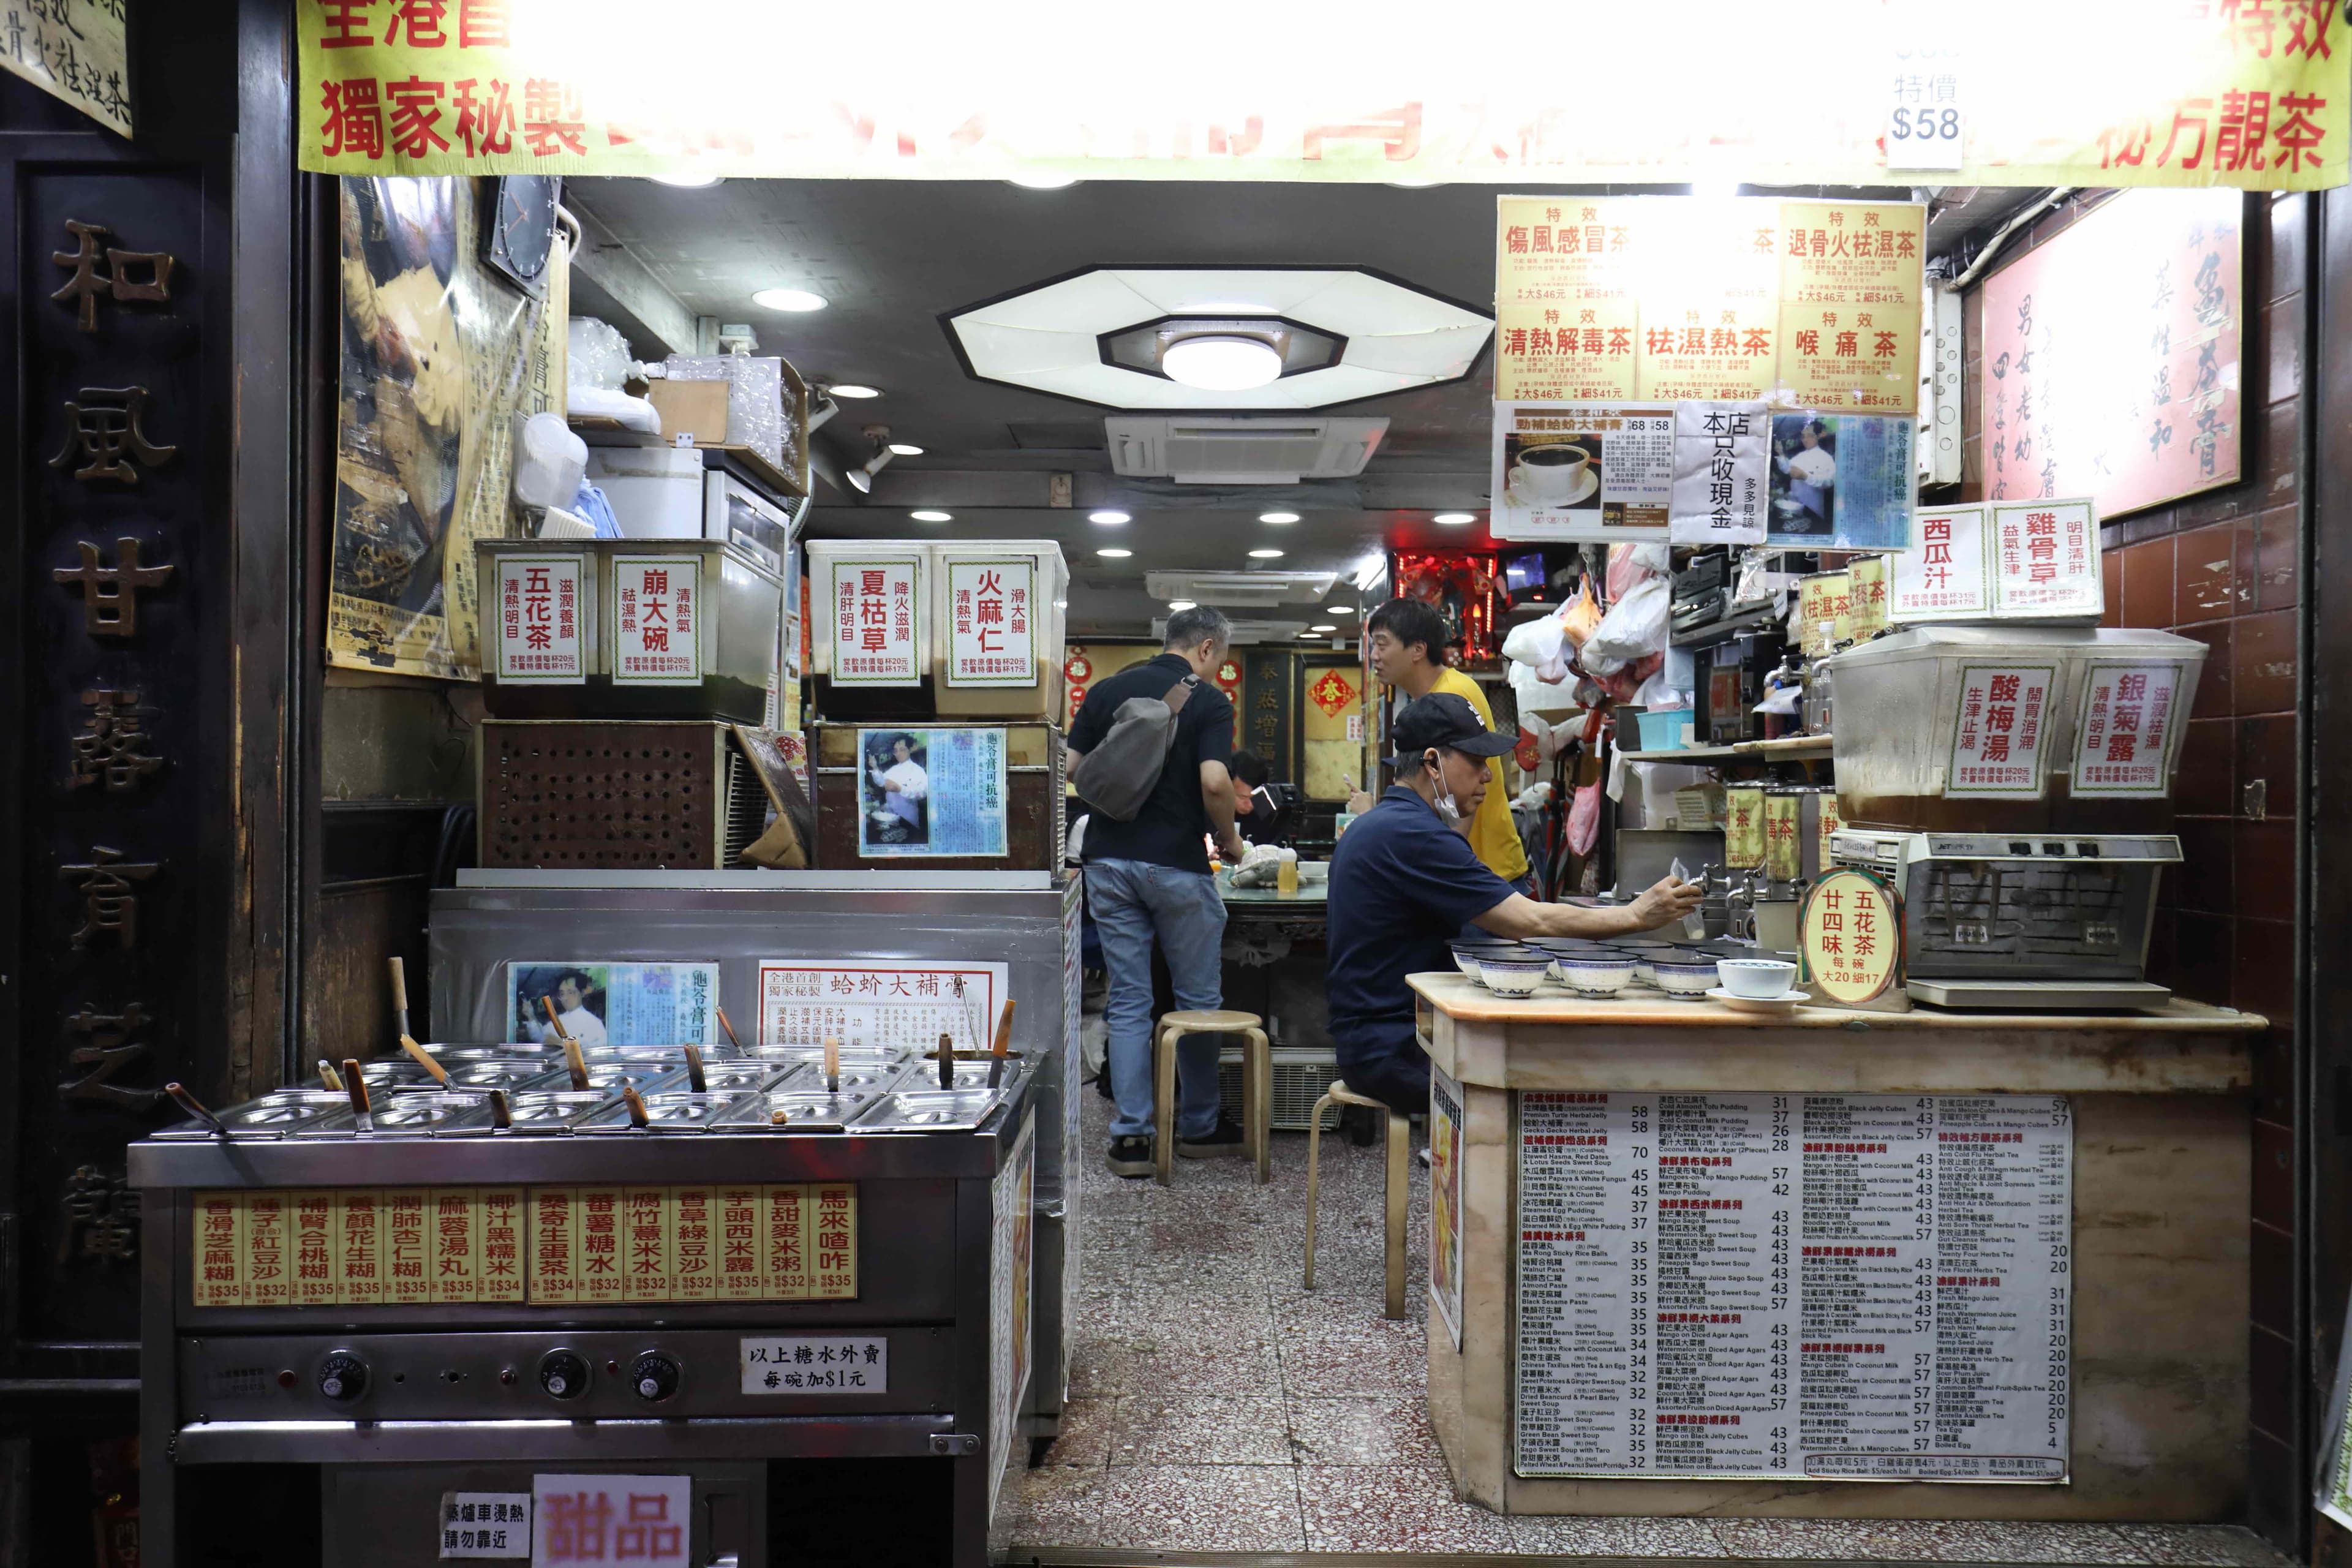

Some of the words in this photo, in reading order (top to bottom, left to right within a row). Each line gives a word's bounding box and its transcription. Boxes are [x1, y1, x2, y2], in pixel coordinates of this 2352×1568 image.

[1894, 74, 1956, 103] 特價
[1892, 107, 1959, 140] $58
[1547, 207, 1597, 223] 特效
[1829, 211, 1879, 227] 特效
[1506, 225, 1630, 254] 傷風感冒茶
[1789, 228, 1916, 258] 退骨火祛濕茶
[1545, 309, 1596, 324] 特效
[1823, 311, 1872, 328] 特效
[1504, 327, 1632, 356] 清熱解毒茶
[1646, 327, 1771, 356] 祛濕熱茶
[1796, 330, 1898, 358] 喉痛茶
[1655, 421, 1668, 431] 58
[1703, 412, 1749, 436] 本店
[1709, 435, 1733, 529] 只收現金
[1742, 478, 1755, 529] 多多見諒
[1923, 519, 1953, 590] 西瓜汁
[2002, 525, 2020, 576] 益氣生津
[2026, 513, 2059, 584] 雞骨草
[2067, 521, 2086, 575] 明目清肝
[505, 579, 519, 638] 清熱明目
[525, 568, 551, 650] 五花茶
[559, 579, 574, 639] 滋潤養顏
[622, 588, 637, 633] 祛濕熱
[643, 570, 668, 652] 崩大碗
[676, 588, 691, 633] 清熱氣
[840, 582, 854, 641] 清肝明目
[861, 570, 887, 653] 夏枯草
[895, 582, 909, 642] 降火滋潤
[957, 589, 971, 634] 清熱氣
[977, 570, 1003, 653] 火麻仁
[1011, 589, 1026, 633] 滑大腸
[1960, 688, 1983, 750] 生津止渴
[1980, 675, 2020, 762] 酸梅湯
[2019, 688, 2042, 750] 開胃消滯
[2087, 687, 2110, 749] 清熱明目
[2106, 674, 2147, 762] 銀菊露
[2145, 688, 2169, 750] 滋潤祛濕
[1822, 889, 1844, 955] 廿四味
[1853, 891, 1875, 956] 五花茶
[769, 972, 821, 984] 全港首創
[1833, 957, 1864, 970] 每碗
[769, 986, 820, 997] 獨家秘製
[1632, 1106, 1648, 1117] 58
[1632, 1121, 1648, 1133] 58
[1773, 1184, 1789, 1195] 42
[204, 1199, 235, 1281] 香滑芝麻糊
[345, 1197, 375, 1279] 養顏花生糊
[392, 1196, 422, 1278] 潤肺杏仁糊
[439, 1196, 469, 1276] 麻蓉湯丸
[486, 1194, 516, 1276] 椰汁黑糯米
[538, 1194, 569, 1275] 桑寄生蛋茶
[585, 1194, 616, 1274] 蕃薯糖水
[631, 1193, 662, 1274] 腐竹薏米水
[678, 1193, 708, 1273] 香草綠豆沙
[725, 1191, 755, 1273] 芋頭西米露
[771, 1191, 801, 1273] 香甜麥米粥
[819, 1191, 849, 1271] 馬來喳咋
[1631, 1259, 1647, 1270] 35
[215, 1285, 239, 1297] $35
[263, 1284, 287, 1296] $32
[310, 1283, 334, 1295] $35
[356, 1283, 380, 1295] $35
[402, 1282, 426, 1294] $35
[450, 1281, 473, 1292] $35
[496, 1280, 520, 1292] $34
[550, 1279, 573, 1292] $34
[597, 1278, 620, 1290] $32
[643, 1277, 666, 1290] $32
[688, 1276, 712, 1289] $32
[735, 1276, 759, 1287] $35
[782, 1275, 805, 1287] $32
[827, 1275, 851, 1286] $35
[2050, 1287, 2064, 1299] 31
[1631, 1292, 1646, 1303] 35
[750, 1344, 880, 1365] 以上糖水外賣
[1915, 1354, 1930, 1365] 57
[763, 1370, 865, 1388] 每碗加$1元
[2048, 1422, 2056, 1433] 5
[2048, 1438, 2057, 1448] 4
[445, 1504, 524, 1523] 蒸爐車燙熱
[544, 1491, 682, 1559] 甜品
[445, 1529, 507, 1549] 請勿靠近
